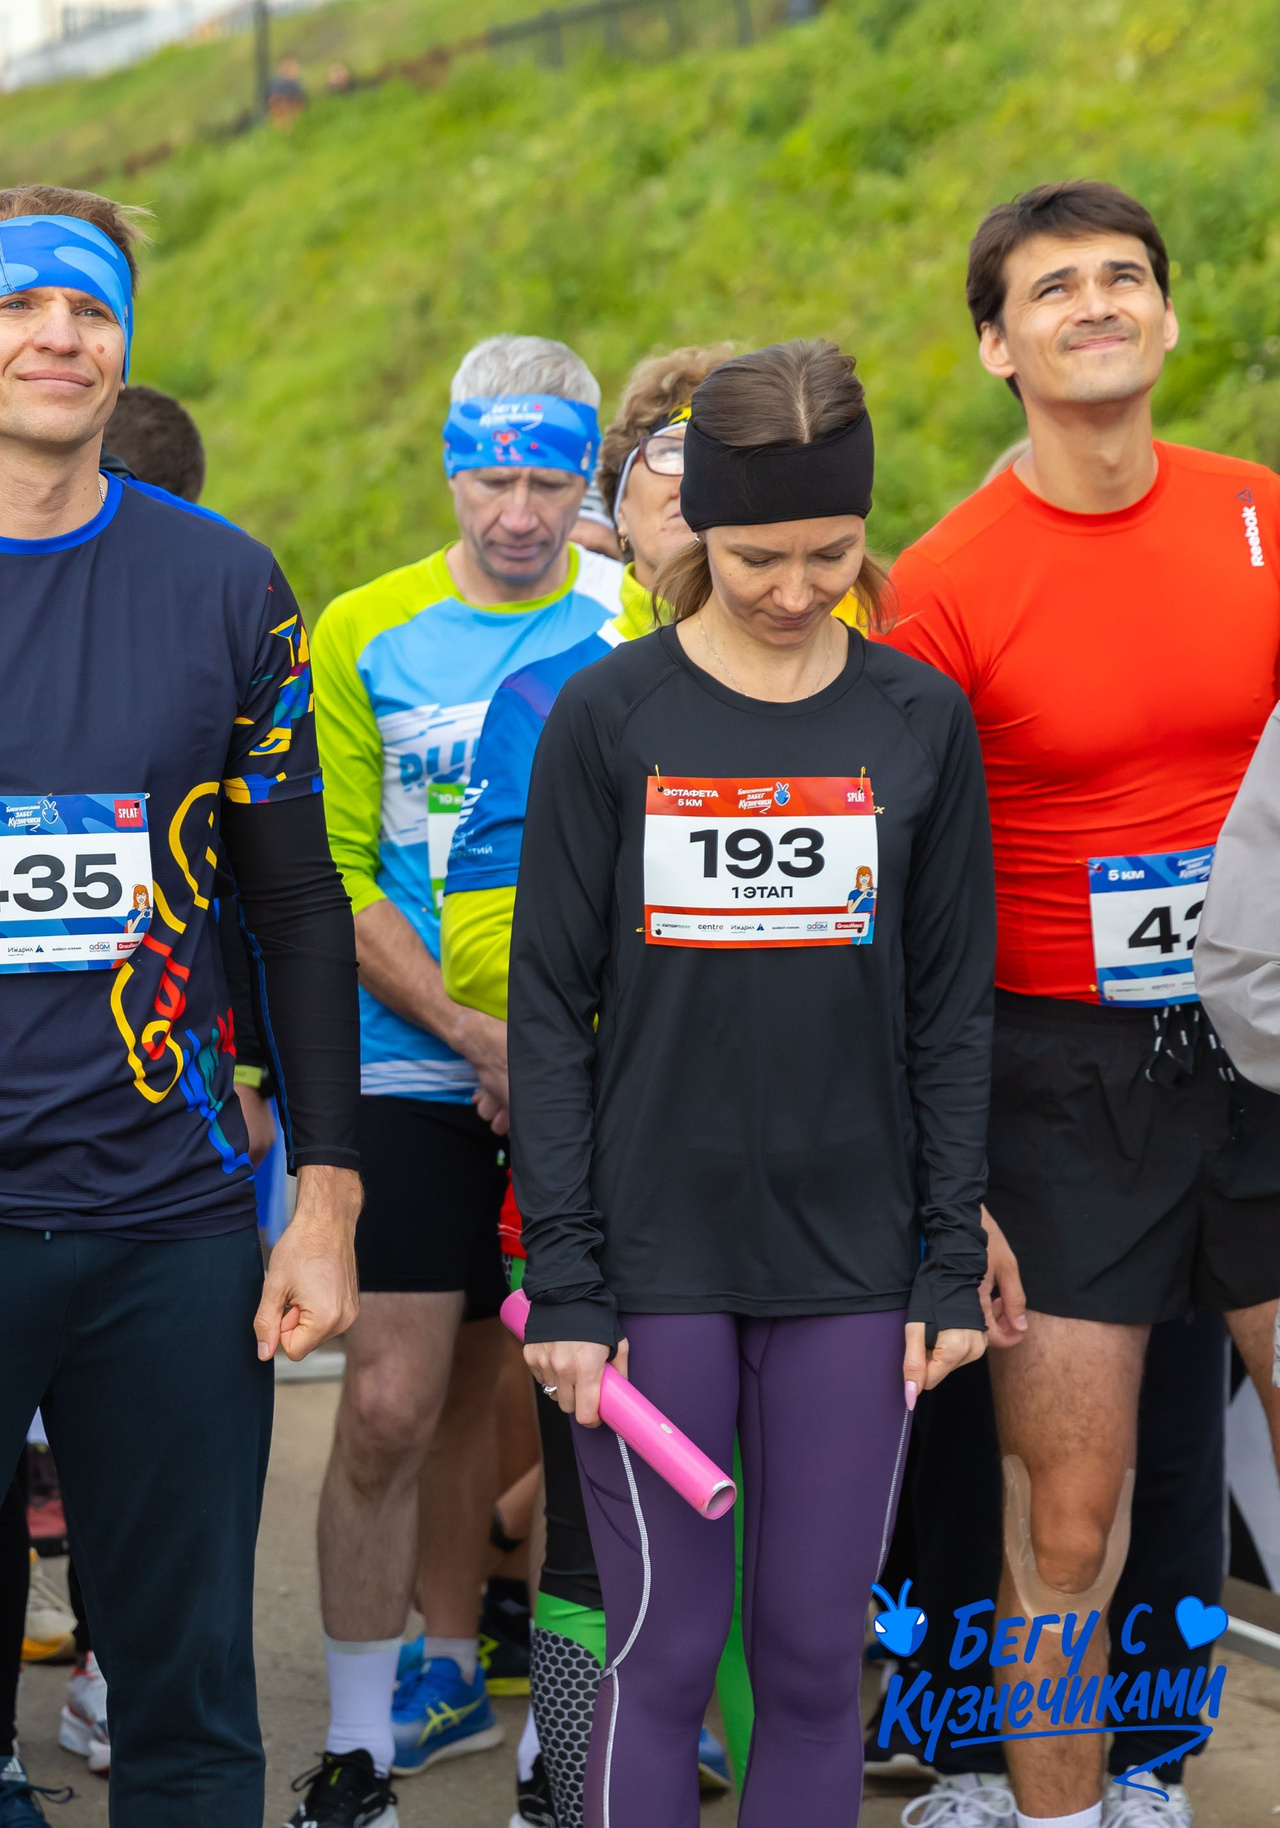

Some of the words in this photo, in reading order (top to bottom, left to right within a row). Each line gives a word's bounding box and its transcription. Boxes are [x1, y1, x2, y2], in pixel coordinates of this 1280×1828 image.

[1241, 505, 1265, 567] Reebok
[663, 788, 719, 798] ЭСТАФЕТА
[847, 791, 865, 802] SPLAT
[677, 798, 685, 807] 5
[118, 807, 138, 820] SPLAT
[689, 827, 825, 879] 193
[1108, 869, 1119, 881] 5
[731, 886, 739, 899] 1
[742, 886, 794, 899] ЭТАП
[697, 922, 724, 931] centre
